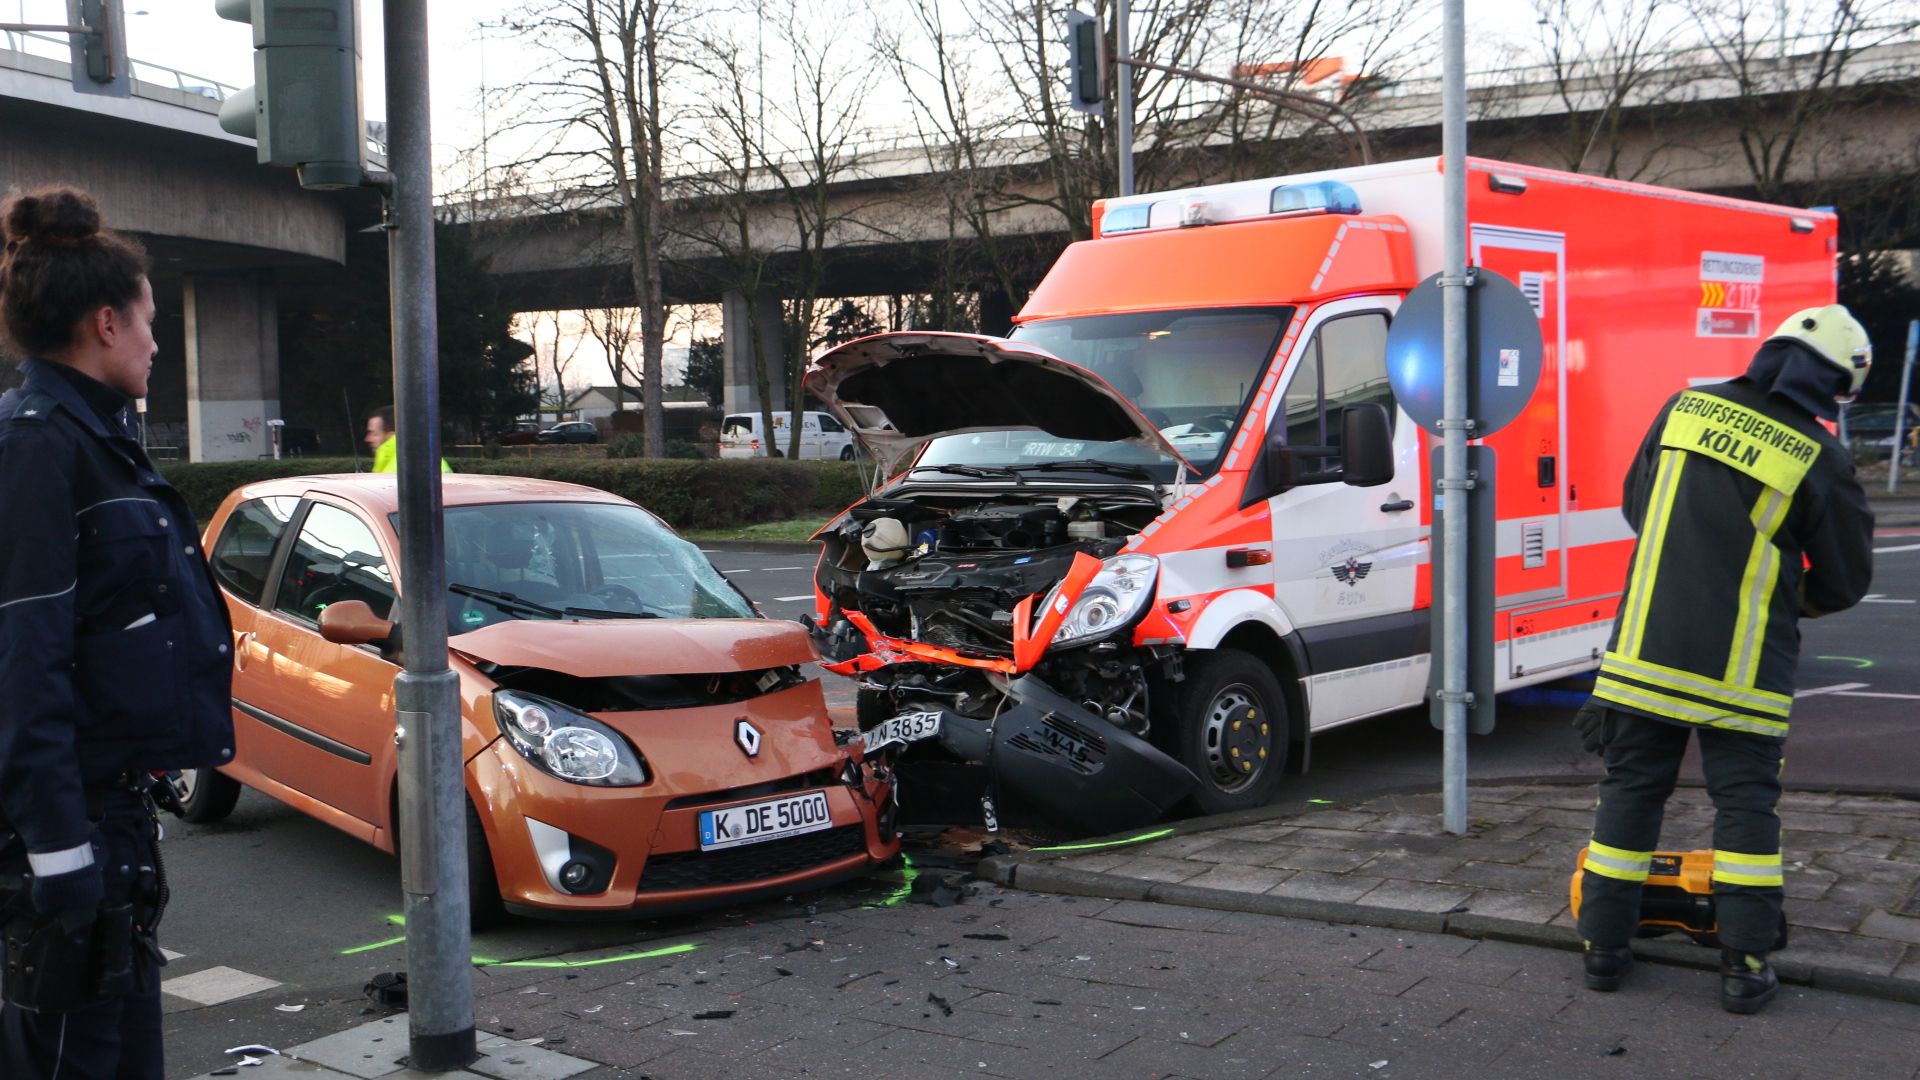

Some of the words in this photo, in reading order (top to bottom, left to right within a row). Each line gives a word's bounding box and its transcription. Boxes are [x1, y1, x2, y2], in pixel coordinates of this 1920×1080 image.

[1739, 283, 1761, 309] 112
[1675, 396, 1815, 464] BERUFSFEUERWEHR
[1024, 442, 1056, 456] RTW
[1697, 427, 1762, 468] KÖLN
[890, 713, 938, 738] 3835
[715, 813, 730, 840] K
[745, 805, 774, 835] DE
[777, 796, 826, 828] 5000
